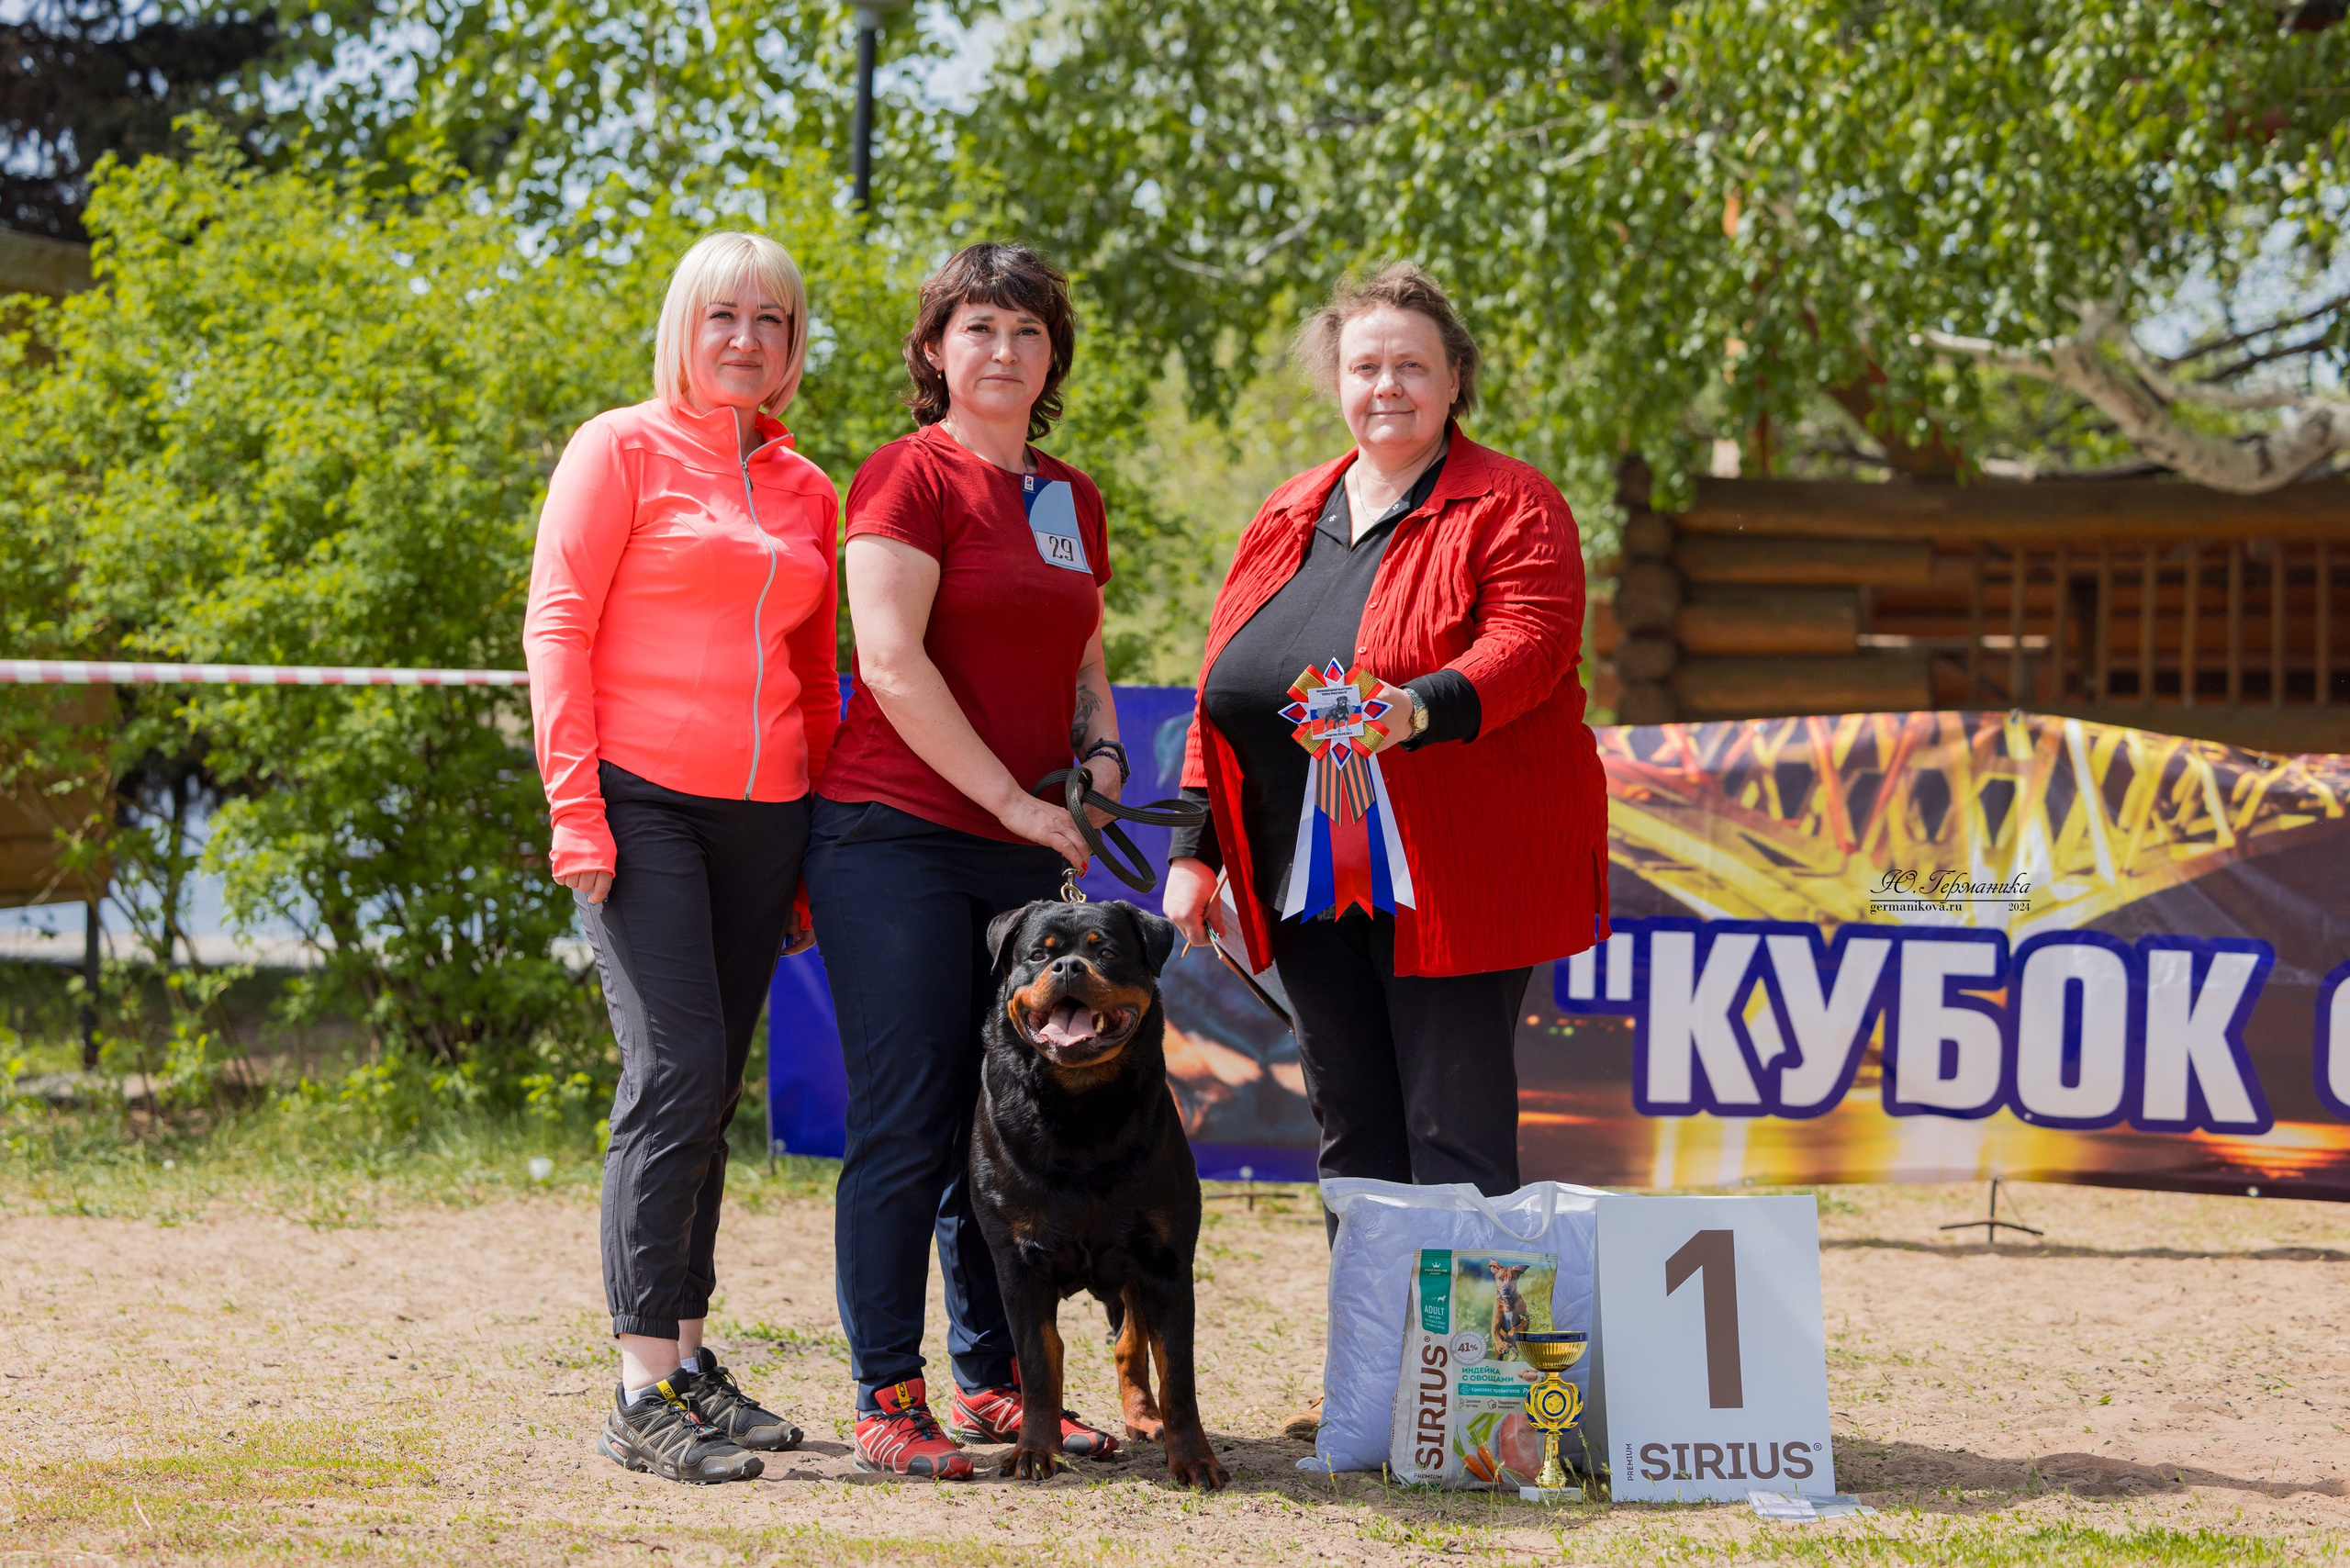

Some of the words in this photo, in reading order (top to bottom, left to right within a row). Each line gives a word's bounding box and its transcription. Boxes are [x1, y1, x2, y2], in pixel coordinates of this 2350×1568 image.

[1048, 535, 1074, 562] 29
[1424, 1305, 1445, 1316] ADULT
[1664, 1228, 1744, 1410] 1
[1457, 1341, 1479, 1352] 41%
[1461, 1365, 1501, 1375] ИНДЕЙКА
[1470, 1374, 1515, 1383] ОВОЩАМИ
[1625, 1443, 1634, 1482] PREMIUM
